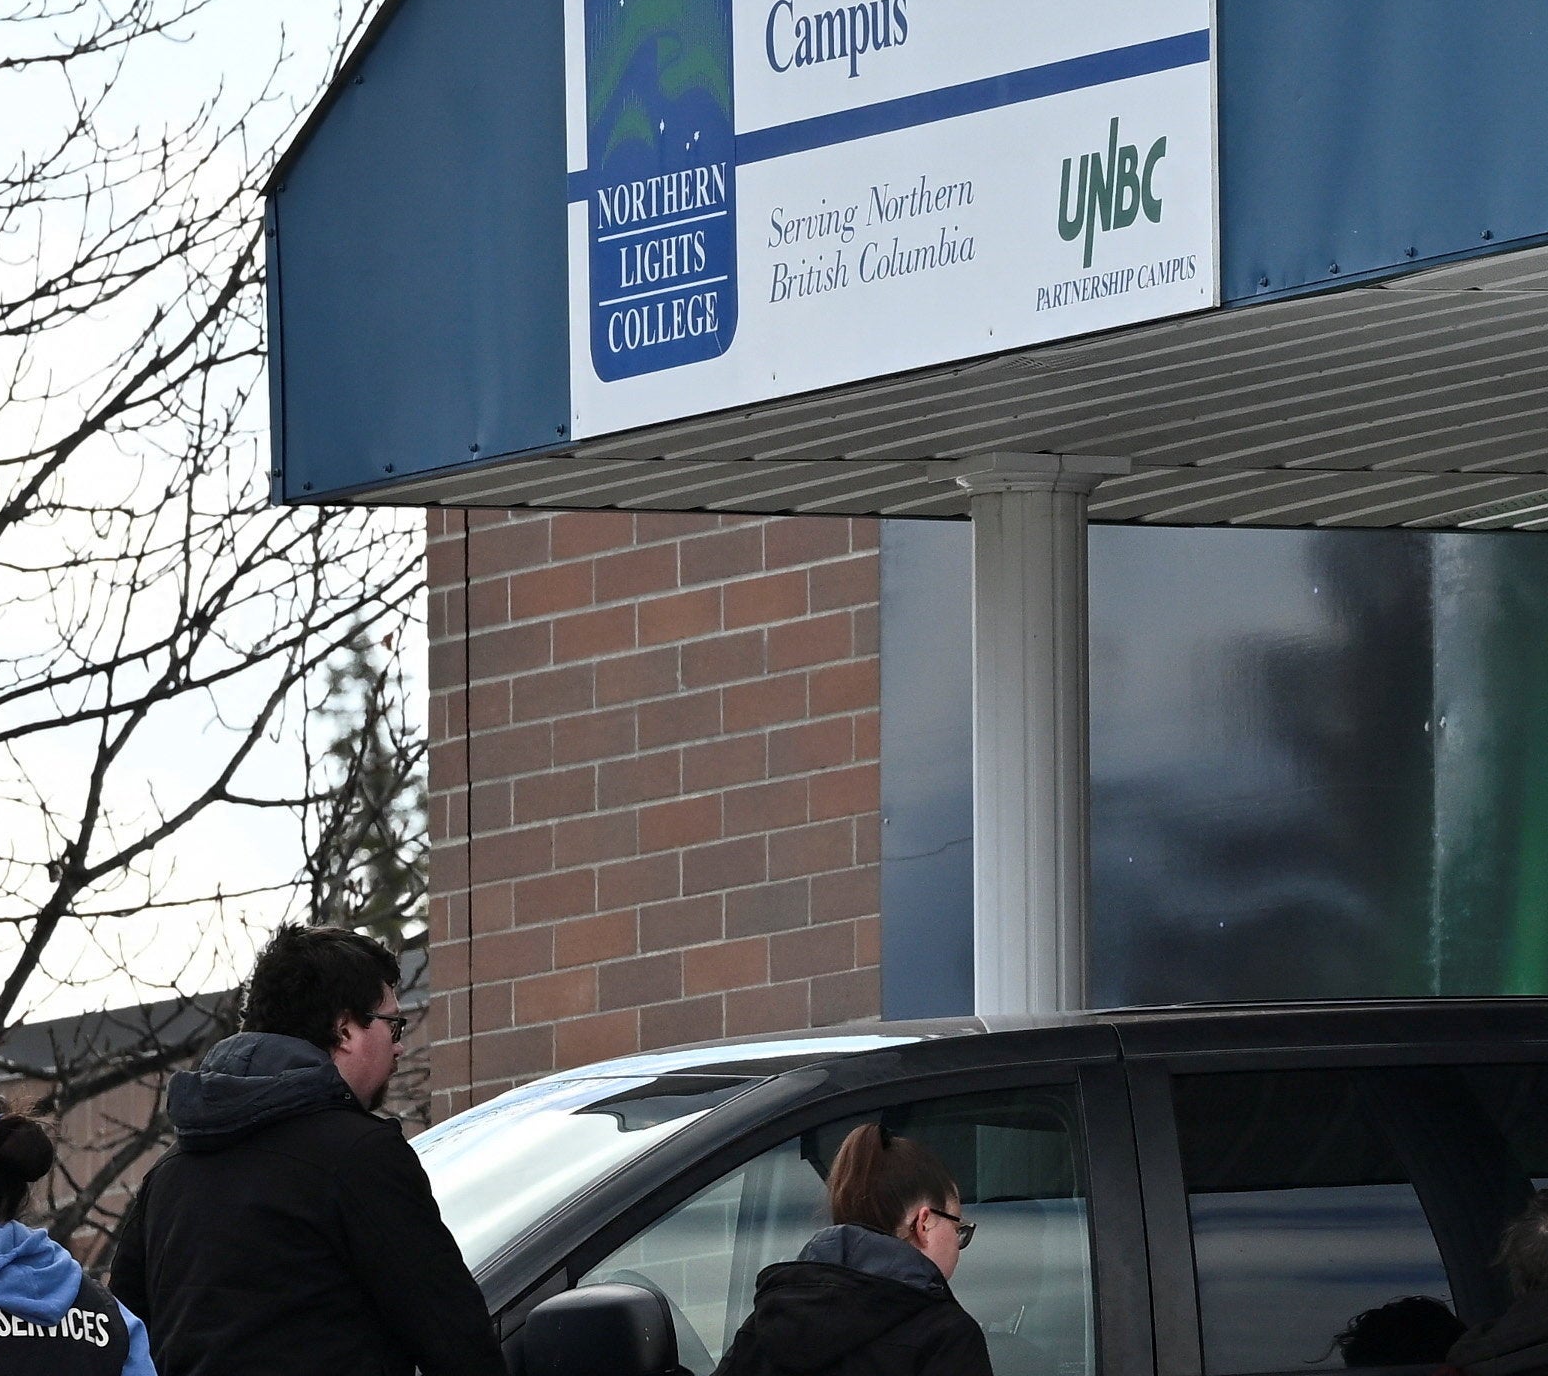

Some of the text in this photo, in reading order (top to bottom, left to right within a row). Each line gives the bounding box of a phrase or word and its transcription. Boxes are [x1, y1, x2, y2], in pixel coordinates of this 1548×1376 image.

[597, 161, 727, 230] NORTHERN
[767, 175, 975, 249] Serving Northern
[1058, 116, 1167, 269] UNBC
[619, 230, 706, 289] LIGHTS
[769, 225, 976, 304] British Columbia
[1035, 254, 1197, 312] PARTNERSHIP CAMPUS
[608, 291, 719, 353] COLLEGE
